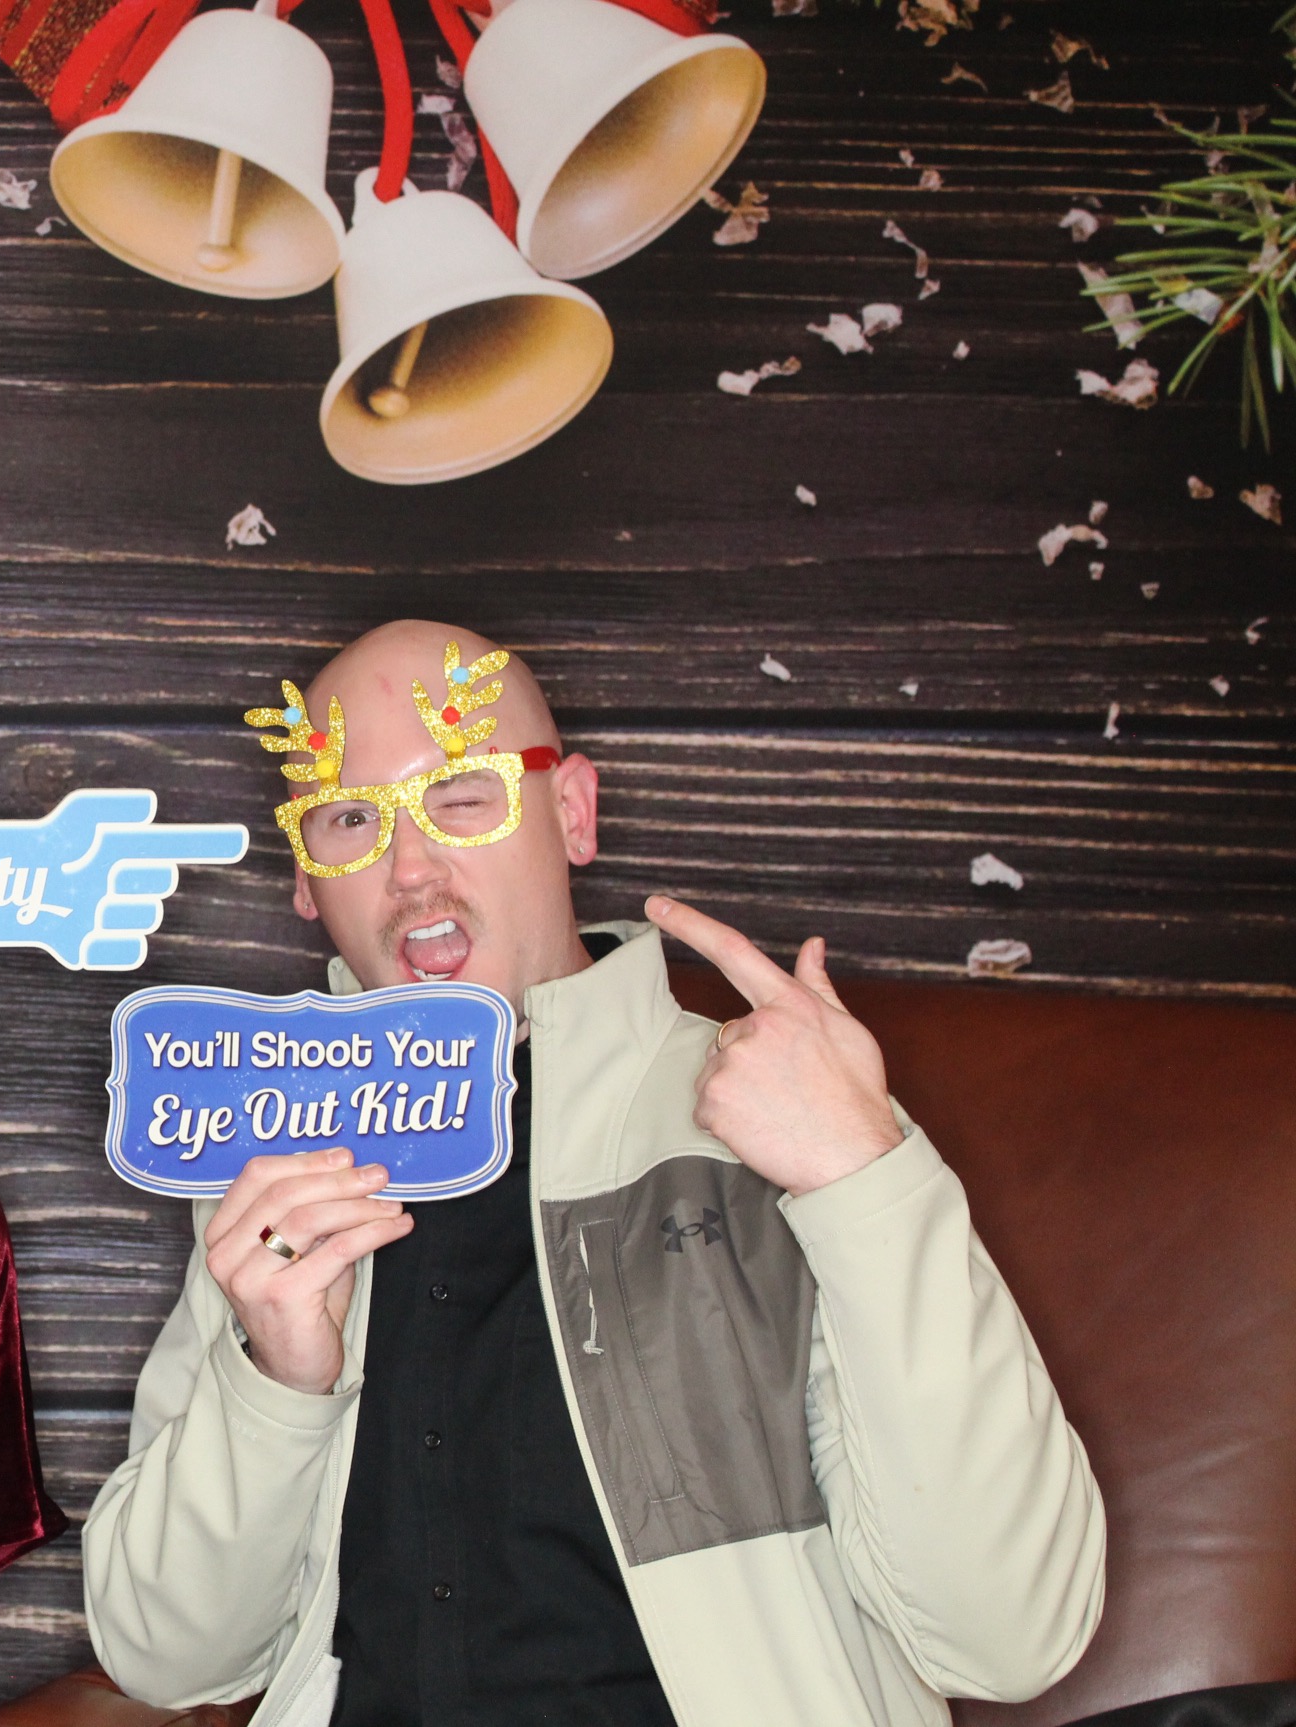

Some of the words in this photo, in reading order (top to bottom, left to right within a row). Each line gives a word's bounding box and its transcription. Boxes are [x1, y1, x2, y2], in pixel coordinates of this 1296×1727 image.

[144, 1030, 240, 1068] You'll
[251, 1031, 373, 1069] Shoot
[385, 1031, 475, 1068] Your
[148, 1093, 235, 1160] Eye
[244, 1087, 344, 1140] Out
[350, 1079, 472, 1136] Kid!
